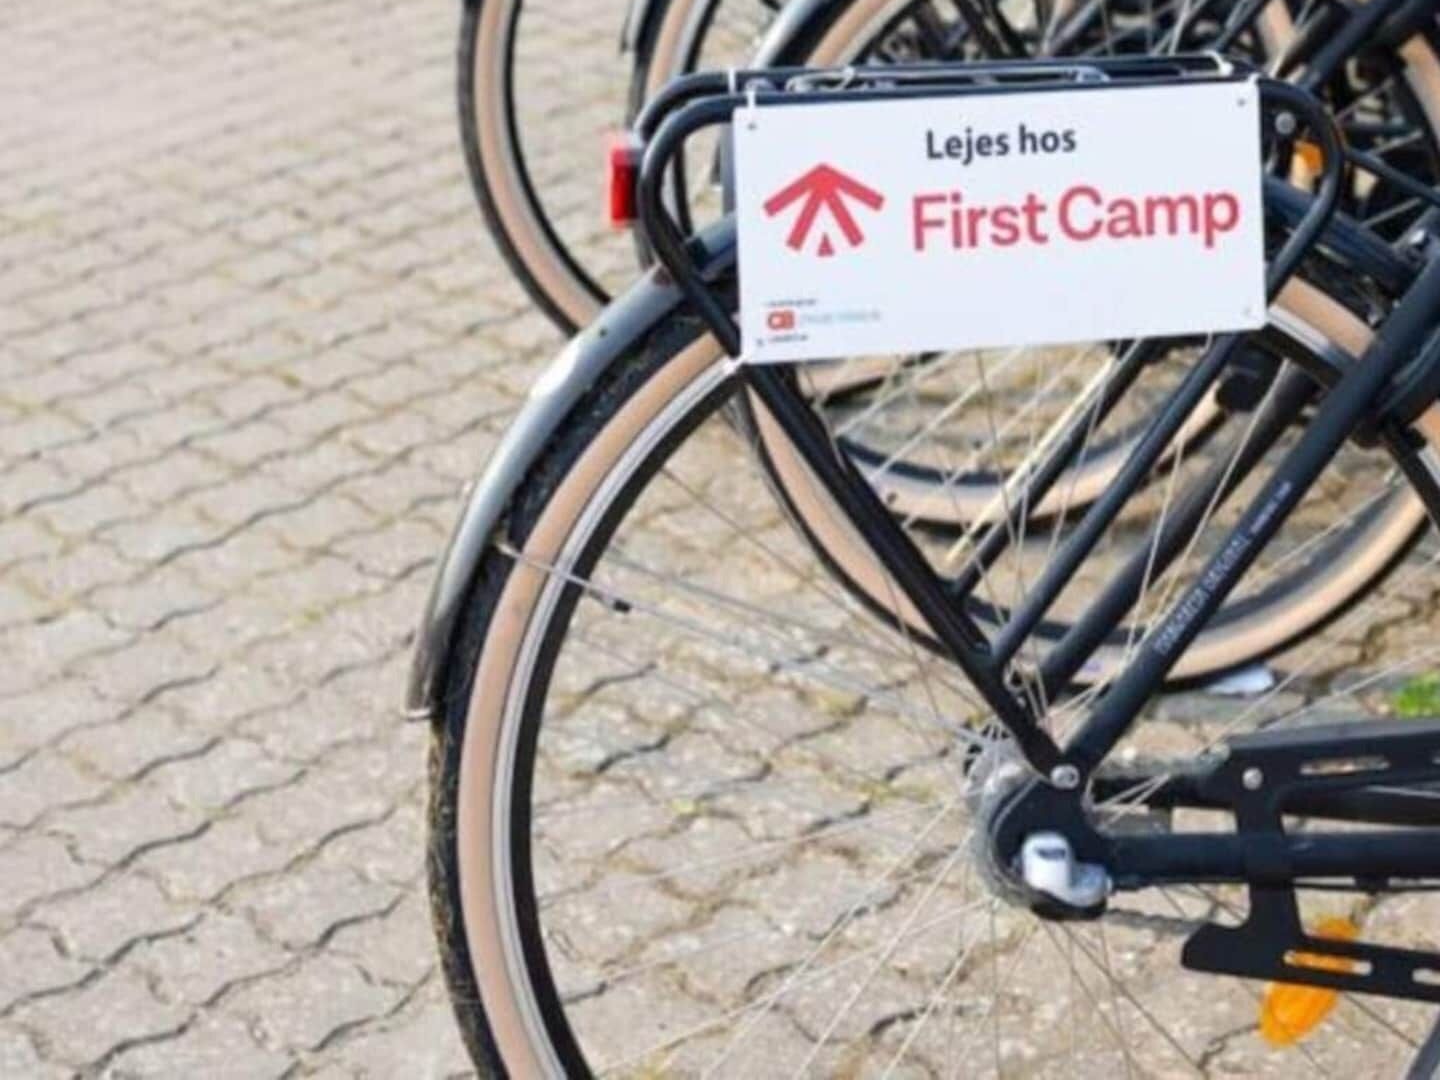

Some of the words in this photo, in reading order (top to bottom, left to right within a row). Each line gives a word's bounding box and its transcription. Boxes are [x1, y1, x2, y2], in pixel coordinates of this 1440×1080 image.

[926, 129, 1010, 166] Lejes
[1018, 123, 1077, 155] hos
[912, 191, 1049, 252] First
[1057, 184, 1240, 249] Camp
